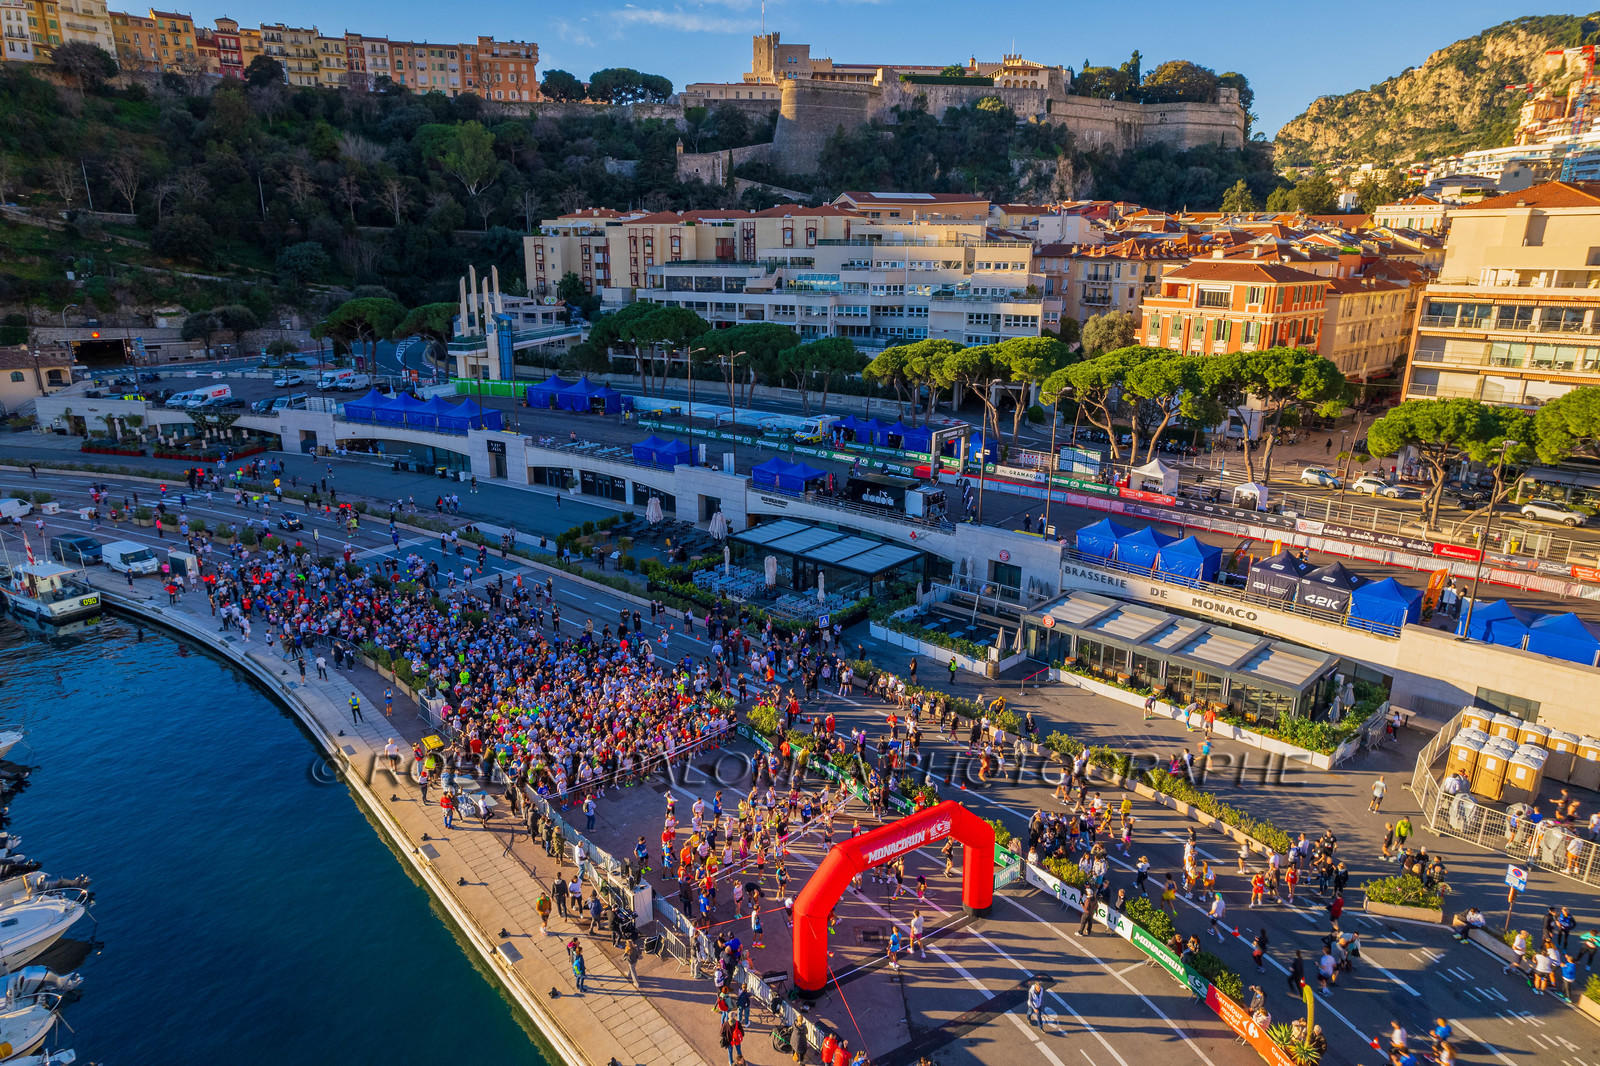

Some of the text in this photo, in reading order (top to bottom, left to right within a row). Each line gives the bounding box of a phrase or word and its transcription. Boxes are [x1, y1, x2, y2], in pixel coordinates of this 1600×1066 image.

[82, 597, 98, 606] 090
[1065, 565, 1258, 621] BRASSERIE DE MONACO
[1305, 594, 1340, 610] 42K
[867, 830, 926, 864] MONACORUN
[1053, 883, 1125, 931] GRAGLIA
[1133, 931, 1185, 976] MONACORUN
[1215, 992, 1243, 1019] Carrefour
[1221, 1006, 1240, 1026] market
